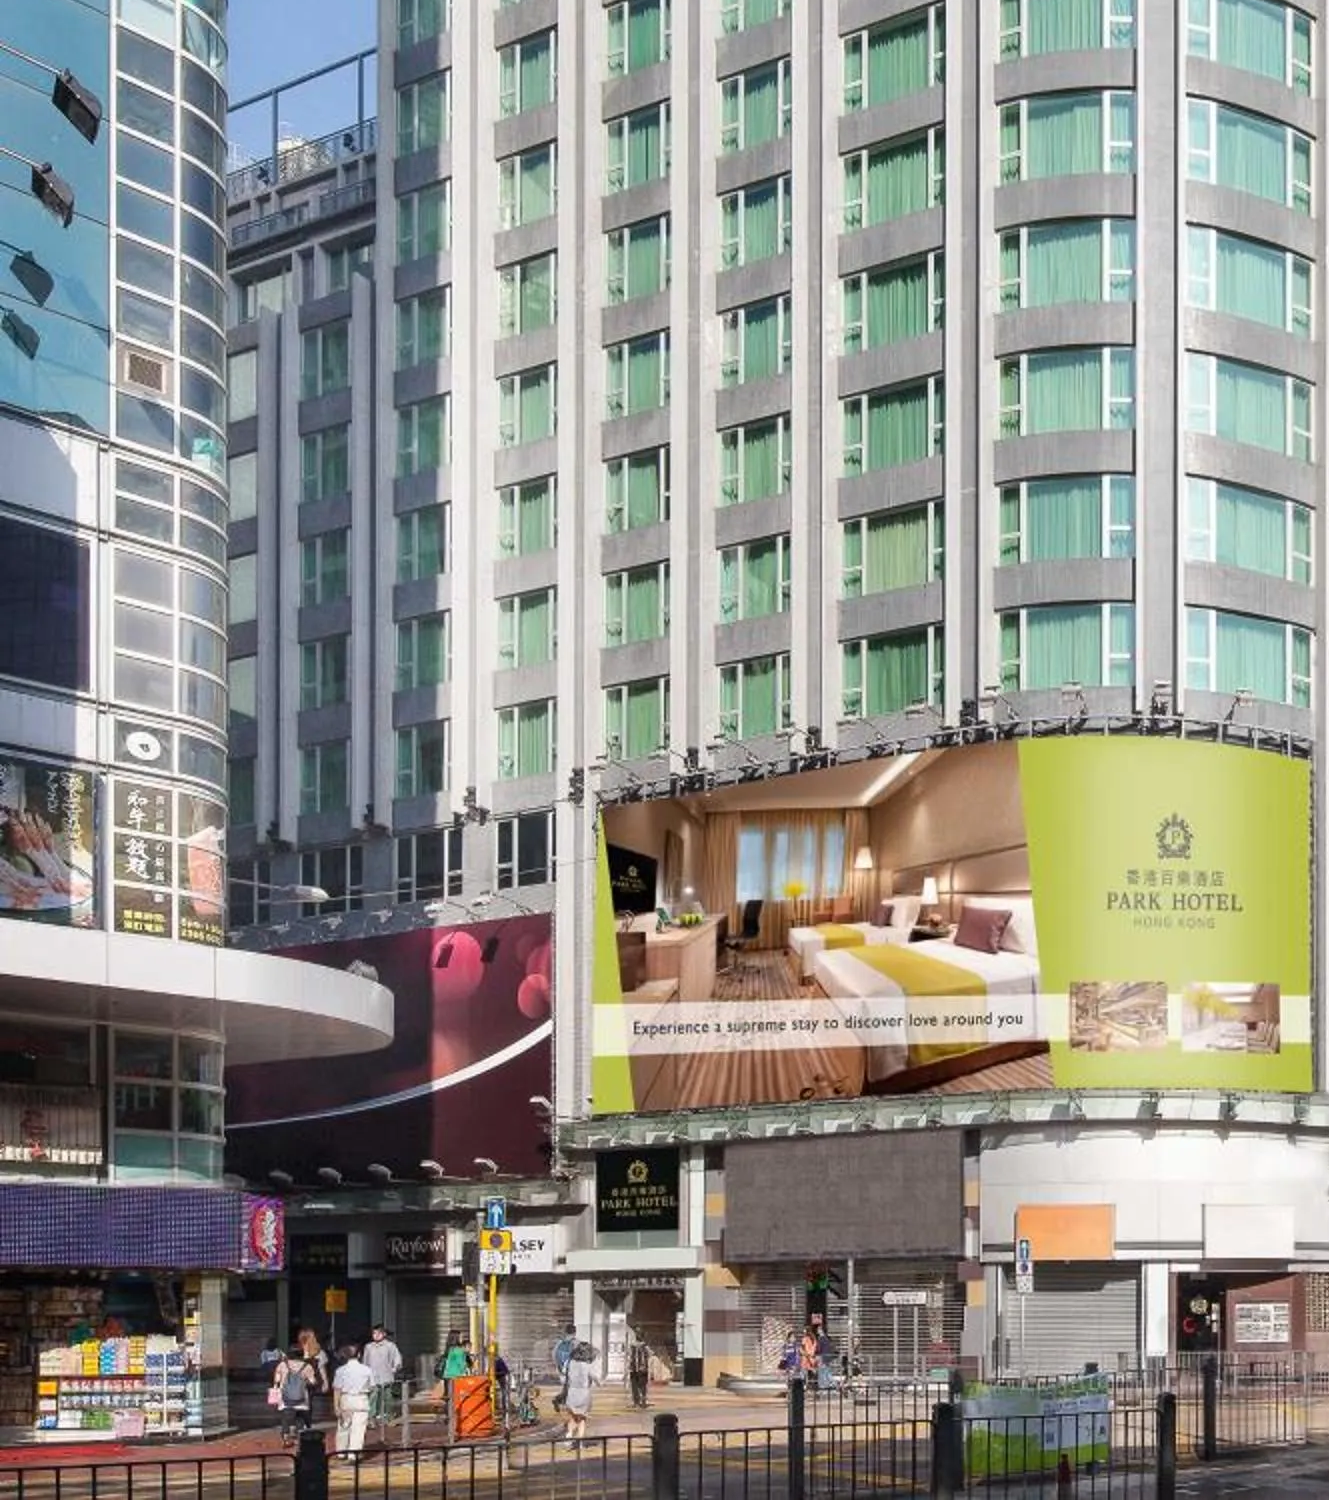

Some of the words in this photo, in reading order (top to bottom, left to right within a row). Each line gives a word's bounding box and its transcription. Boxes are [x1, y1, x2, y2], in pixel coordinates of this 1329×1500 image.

[1106, 891, 1161, 911] PARK
[1172, 892, 1244, 913] HOTEL
[1133, 915, 1172, 929] HONG
[1178, 916, 1216, 930] KONG
[633, 1020, 709, 1039] Experience
[714, 1022, 721, 1033] a
[727, 1019, 786, 1036] supreme
[791, 1016, 820, 1034] stay
[823, 1017, 839, 1029] to
[844, 1013, 903, 1030] discover
[909, 1012, 938, 1028] love
[943, 1011, 993, 1027] around
[997, 1013, 1024, 1029] you
[601, 1199, 632, 1209] PARK
[636, 1195, 676, 1208] HOTEL
